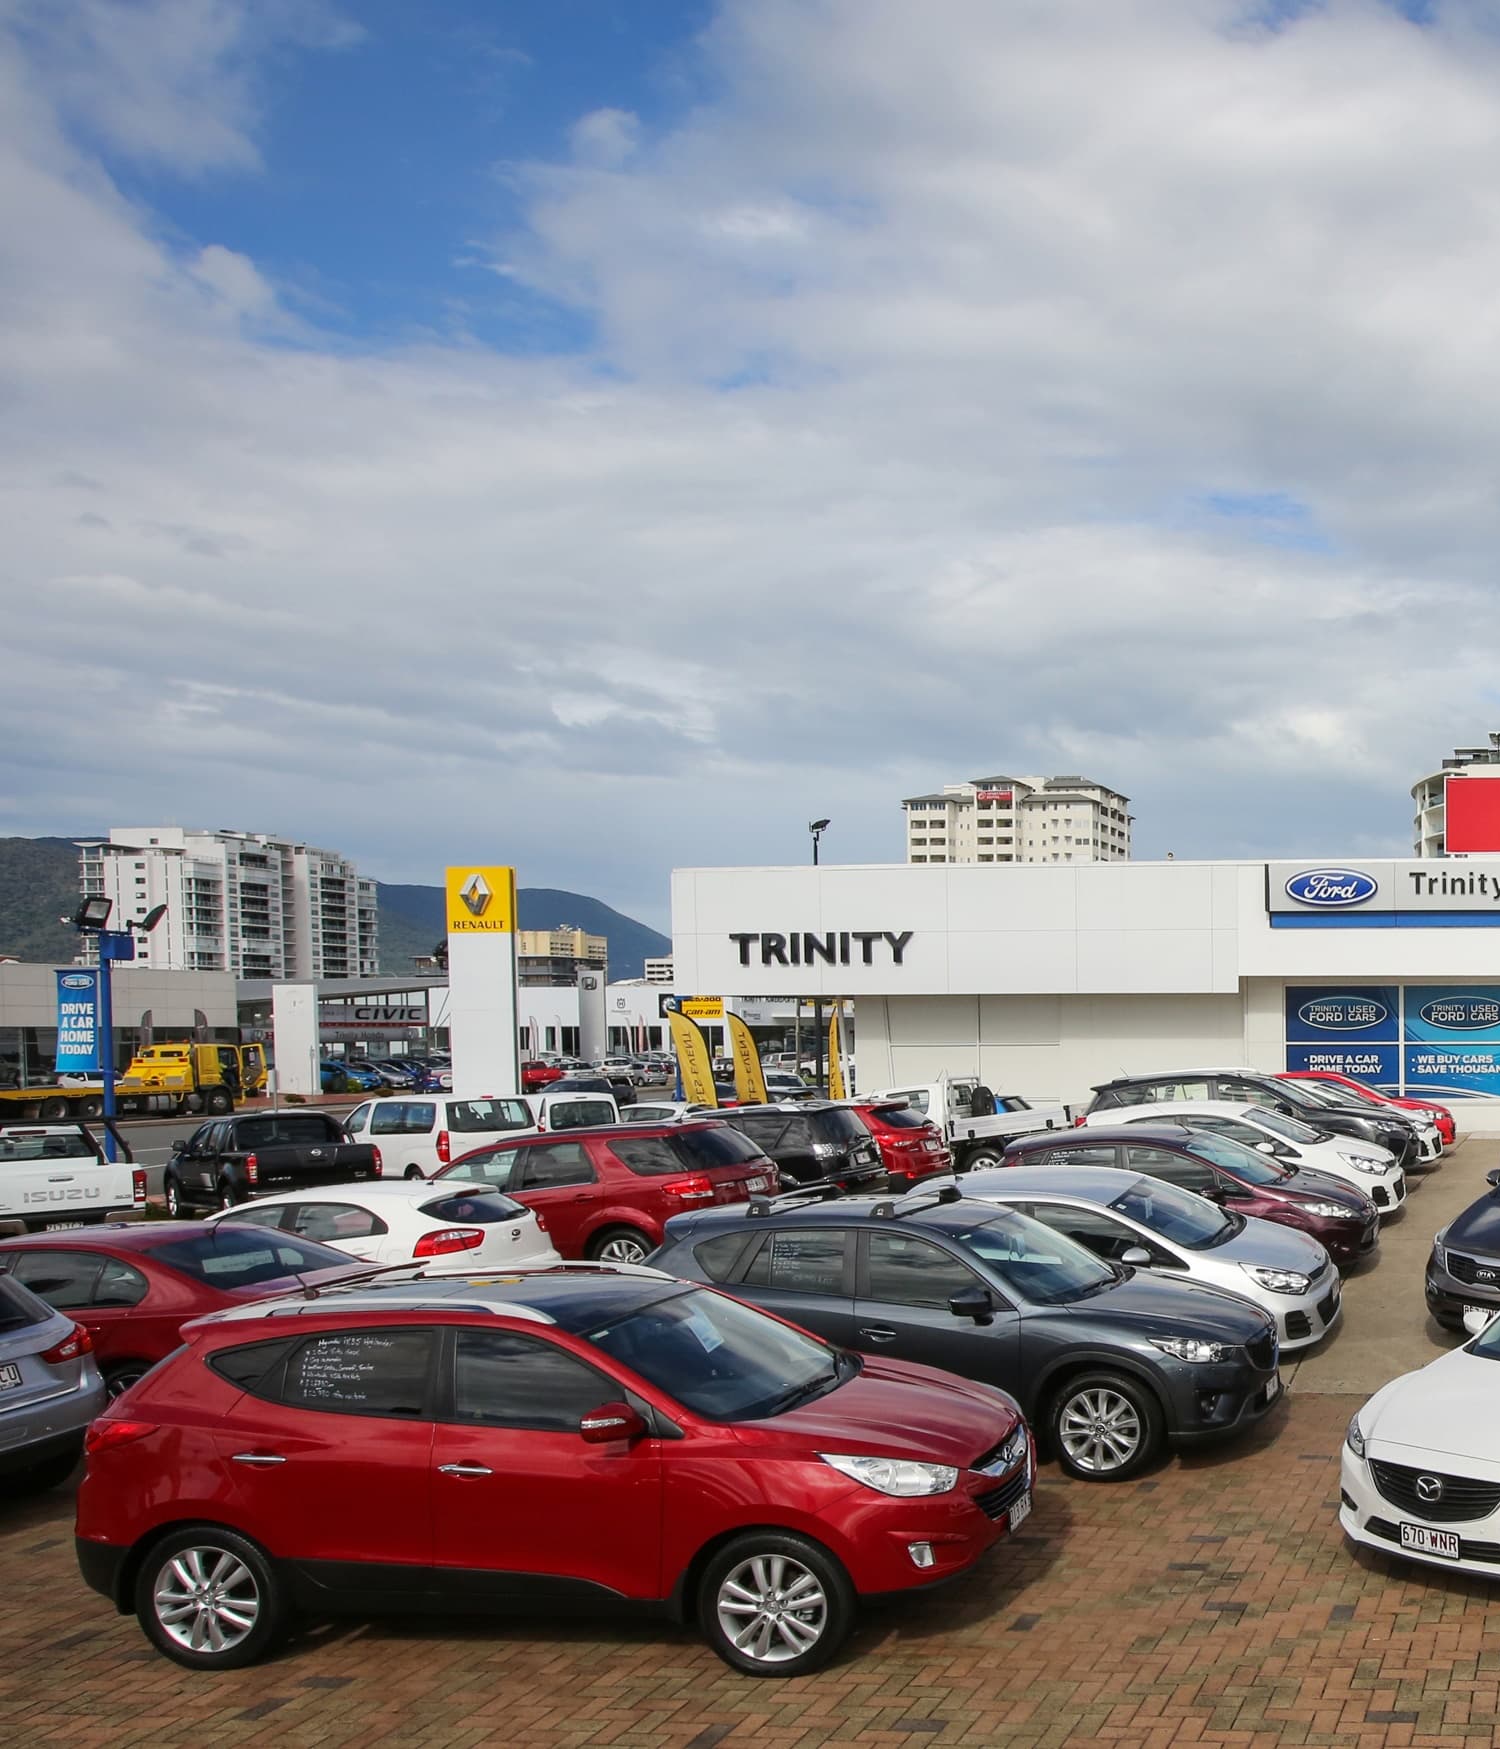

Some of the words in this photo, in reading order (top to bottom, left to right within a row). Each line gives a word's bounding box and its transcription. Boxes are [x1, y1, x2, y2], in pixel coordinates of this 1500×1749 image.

[1303, 875, 1358, 899] Ford
[453, 921, 504, 929] RENAULT
[729, 932, 914, 966] TRINITY
[61, 1003, 94, 1015] DRIVE
[685, 1008, 721, 1016] can-am
[1348, 1005, 1376, 1013] USED
[1470, 1004, 1499, 1013] USED
[355, 1008, 422, 1020] CIVIC
[1309, 1012, 1343, 1021] FORD
[1348, 1013, 1376, 1021] CARS
[1431, 1011, 1465, 1021] FORD
[1470, 1013, 1499, 1021] CARS
[62, 1017, 69, 1028] A
[70, 1017, 94, 1028] CAR
[60, 1031, 94, 1042] HOME
[60, 1044, 94, 1055] TODAY
[1309, 1055, 1344, 1064] DRIVE
[1345, 1055, 1354, 1063] A
[1355, 1055, 1379, 1064] CAR
[1417, 1055, 1436, 1063] WE
[1437, 1055, 1461, 1063] BUY
[1463, 1055, 1493, 1063] CARS
[1309, 1065, 1343, 1073] HOME
[1344, 1065, 1383, 1074] TODAY
[1417, 1065, 1447, 1073] SAVE
[24, 1188, 100, 1203] ISUZU
[1403, 1526, 1425, 1545] 670
[1430, 1531, 1457, 1552] WNR
